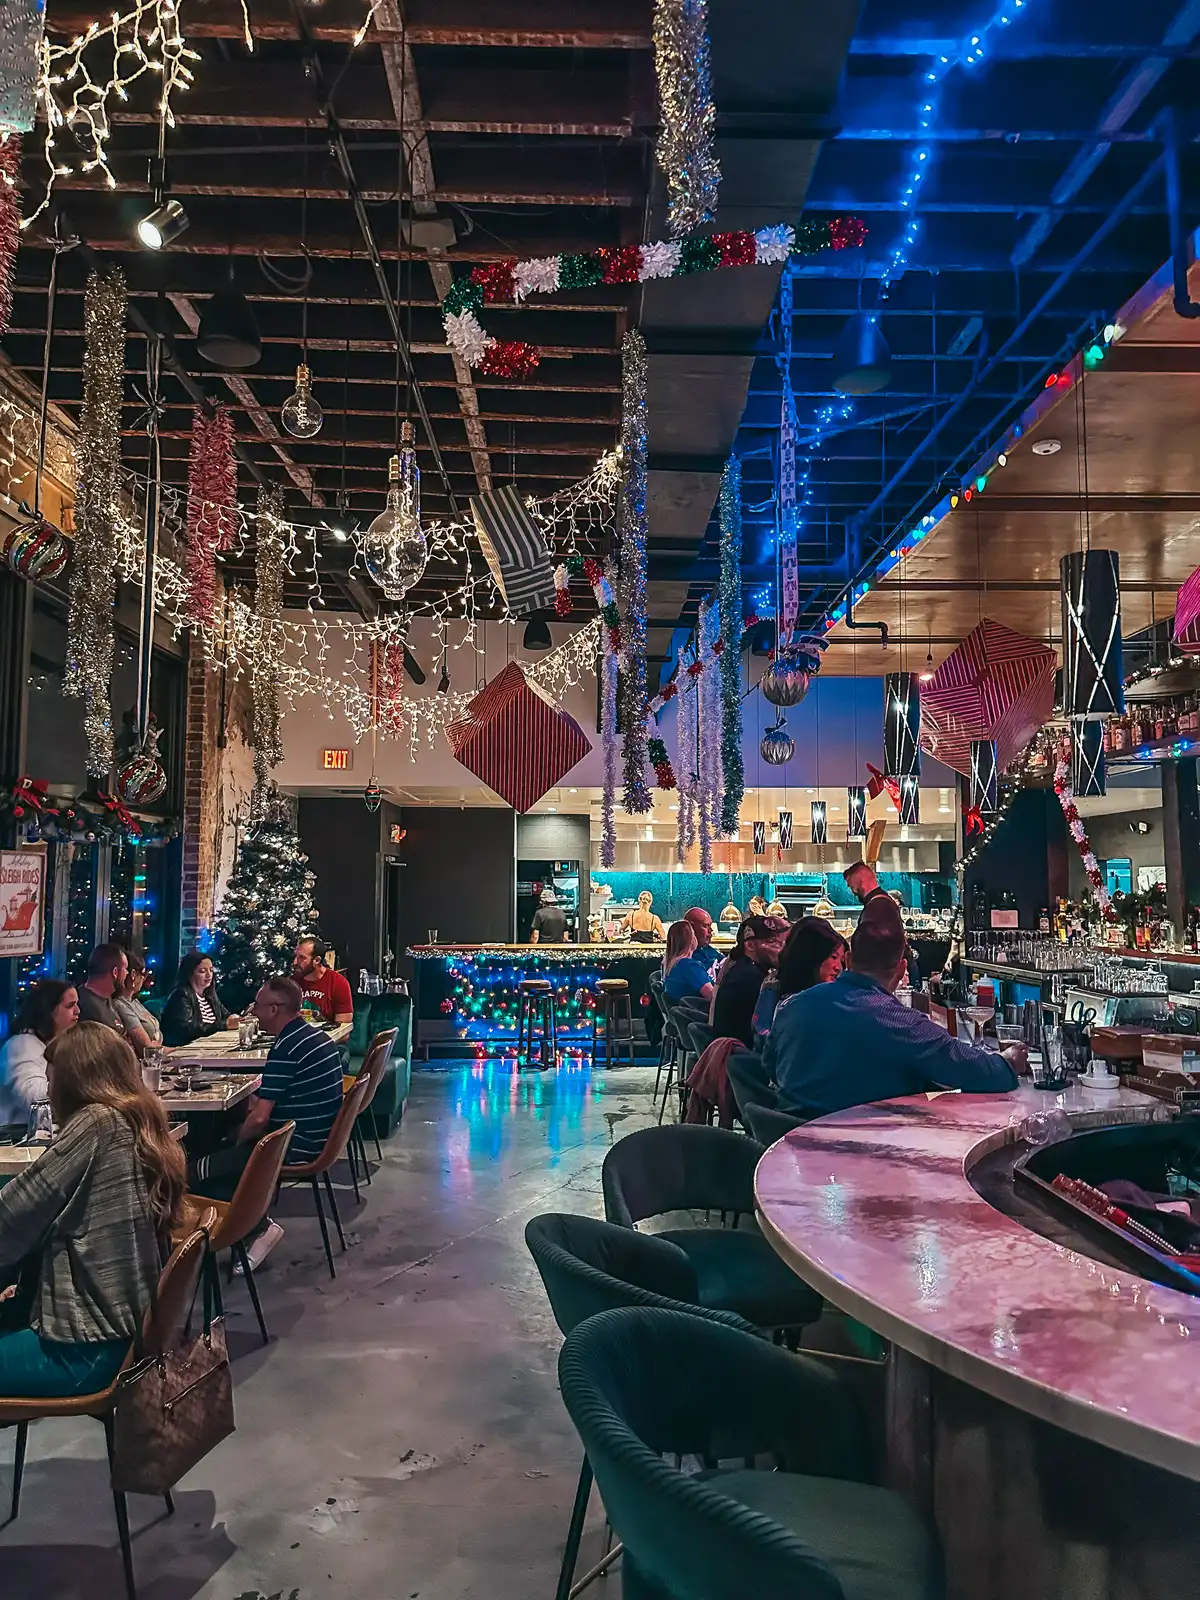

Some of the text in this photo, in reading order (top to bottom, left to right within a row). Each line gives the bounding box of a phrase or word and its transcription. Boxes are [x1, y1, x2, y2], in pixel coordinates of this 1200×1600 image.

[324, 750, 348, 769] EXIT
[0, 867, 40, 885] SLEIGH RIDES
